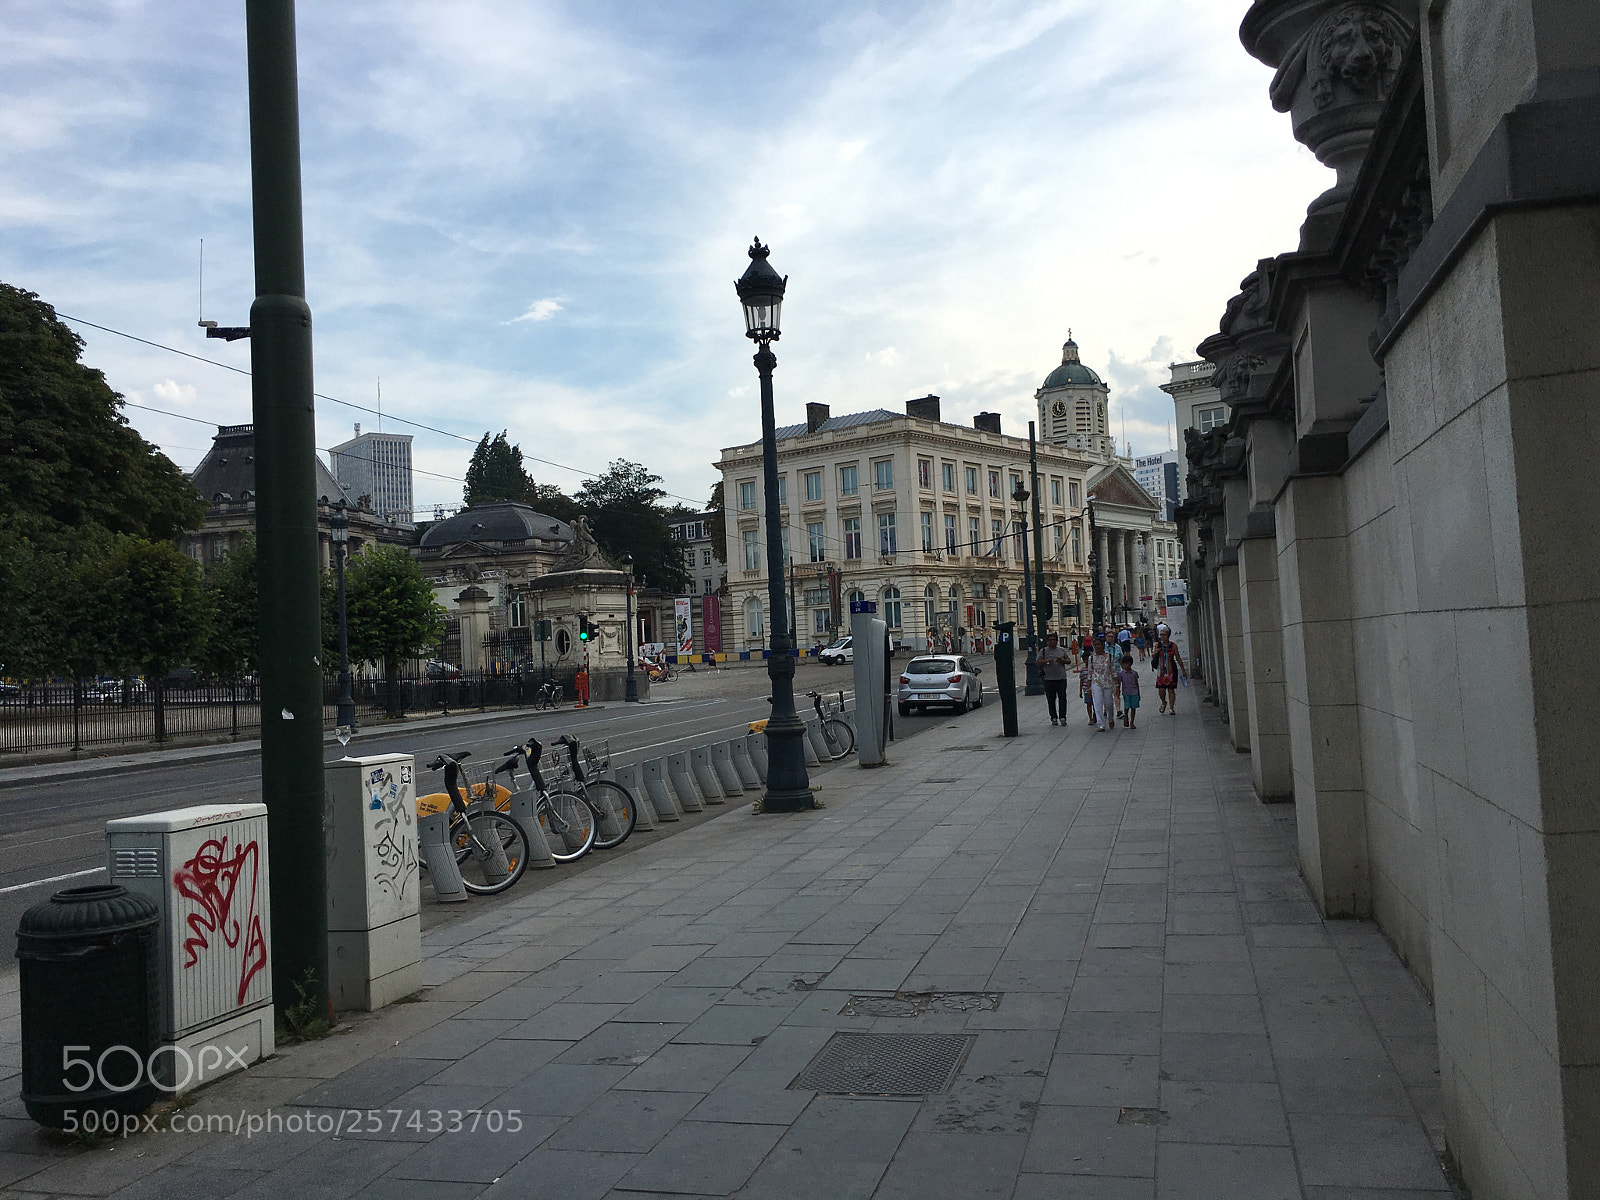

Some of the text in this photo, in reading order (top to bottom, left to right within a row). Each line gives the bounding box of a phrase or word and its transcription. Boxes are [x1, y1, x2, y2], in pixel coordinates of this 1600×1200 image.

[1135, 455, 1163, 468] The Hotel
[1002, 632, 1009, 642] P
